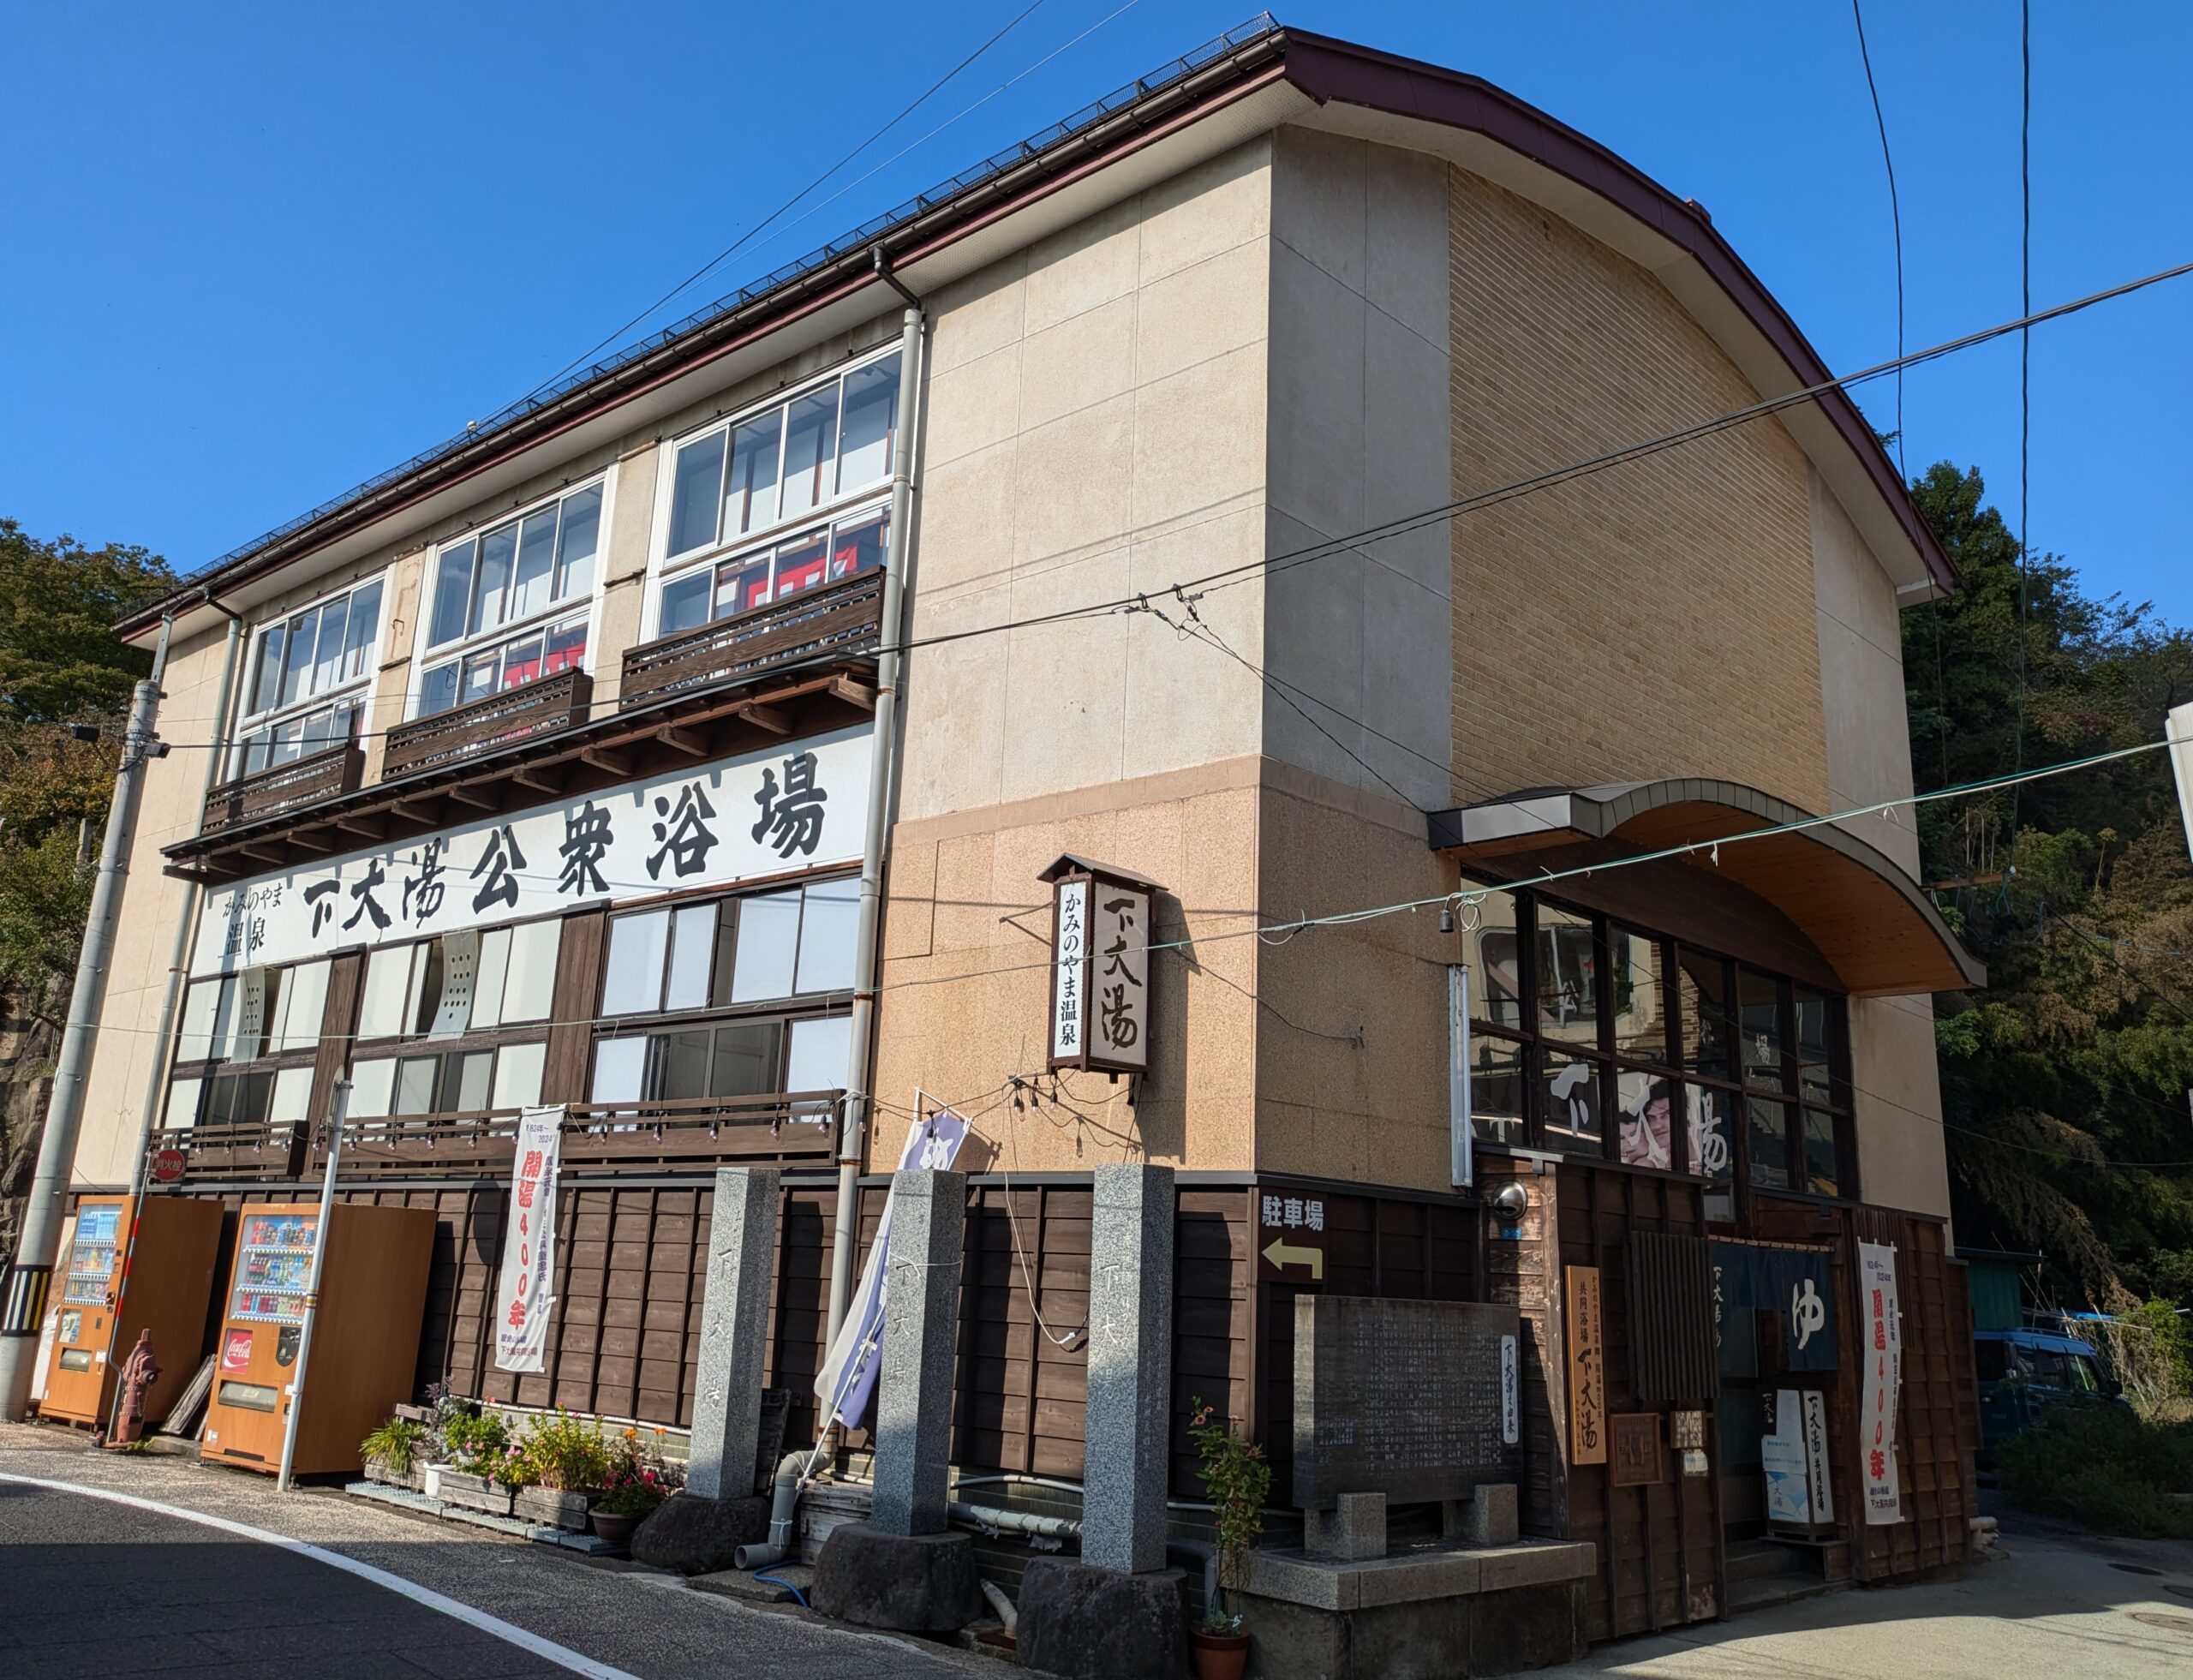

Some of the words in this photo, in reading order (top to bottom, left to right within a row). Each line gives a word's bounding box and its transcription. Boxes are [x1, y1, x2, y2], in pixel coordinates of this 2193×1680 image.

[303, 752, 828, 939] 下大湯公衆浴場
[223, 883, 283, 918] かみのやま
[226, 917, 266, 956] 温泉
[1060, 894, 1081, 1046] かみのやま温泉
[1101, 898, 1143, 1050] 下大湯
[155, 1157, 182, 1172] 消火栓
[1262, 1195, 1324, 1231] 駐車場
[1579, 1281, 1589, 1343] 共同浴場
[1792, 1278, 1825, 1350] ゆ
[1578, 1348, 1597, 1450] 下大湯
[1808, 1396, 1821, 1455] 下大湯
